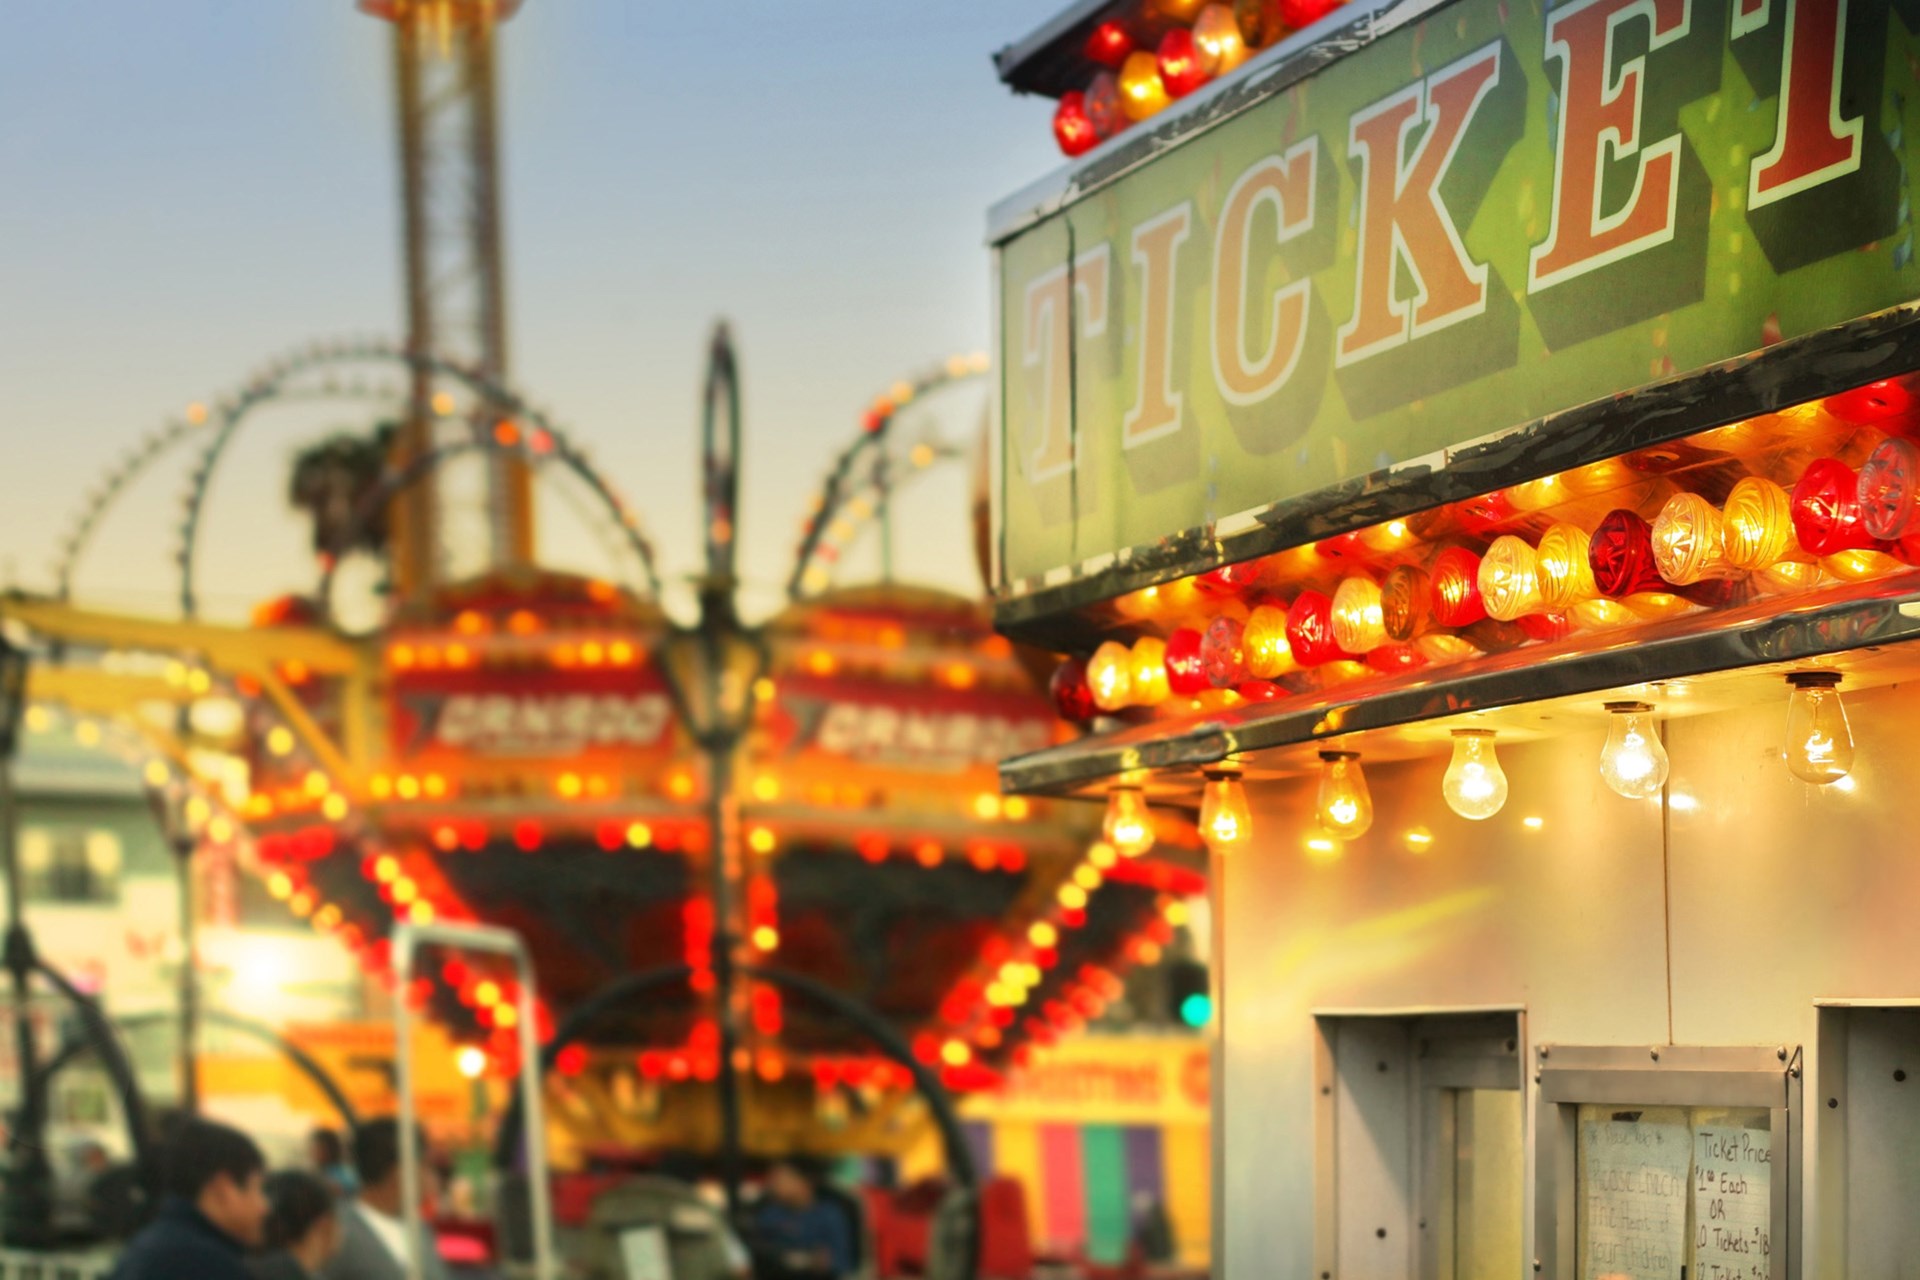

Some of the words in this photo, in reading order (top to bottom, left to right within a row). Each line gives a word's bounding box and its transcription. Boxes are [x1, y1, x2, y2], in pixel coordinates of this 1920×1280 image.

[1700, 1132, 1738, 1161] Ticket
[1721, 1172, 1747, 1194] Each
[1710, 1198, 1725, 1219] OR
[1713, 1227, 1749, 1254] Tickets
